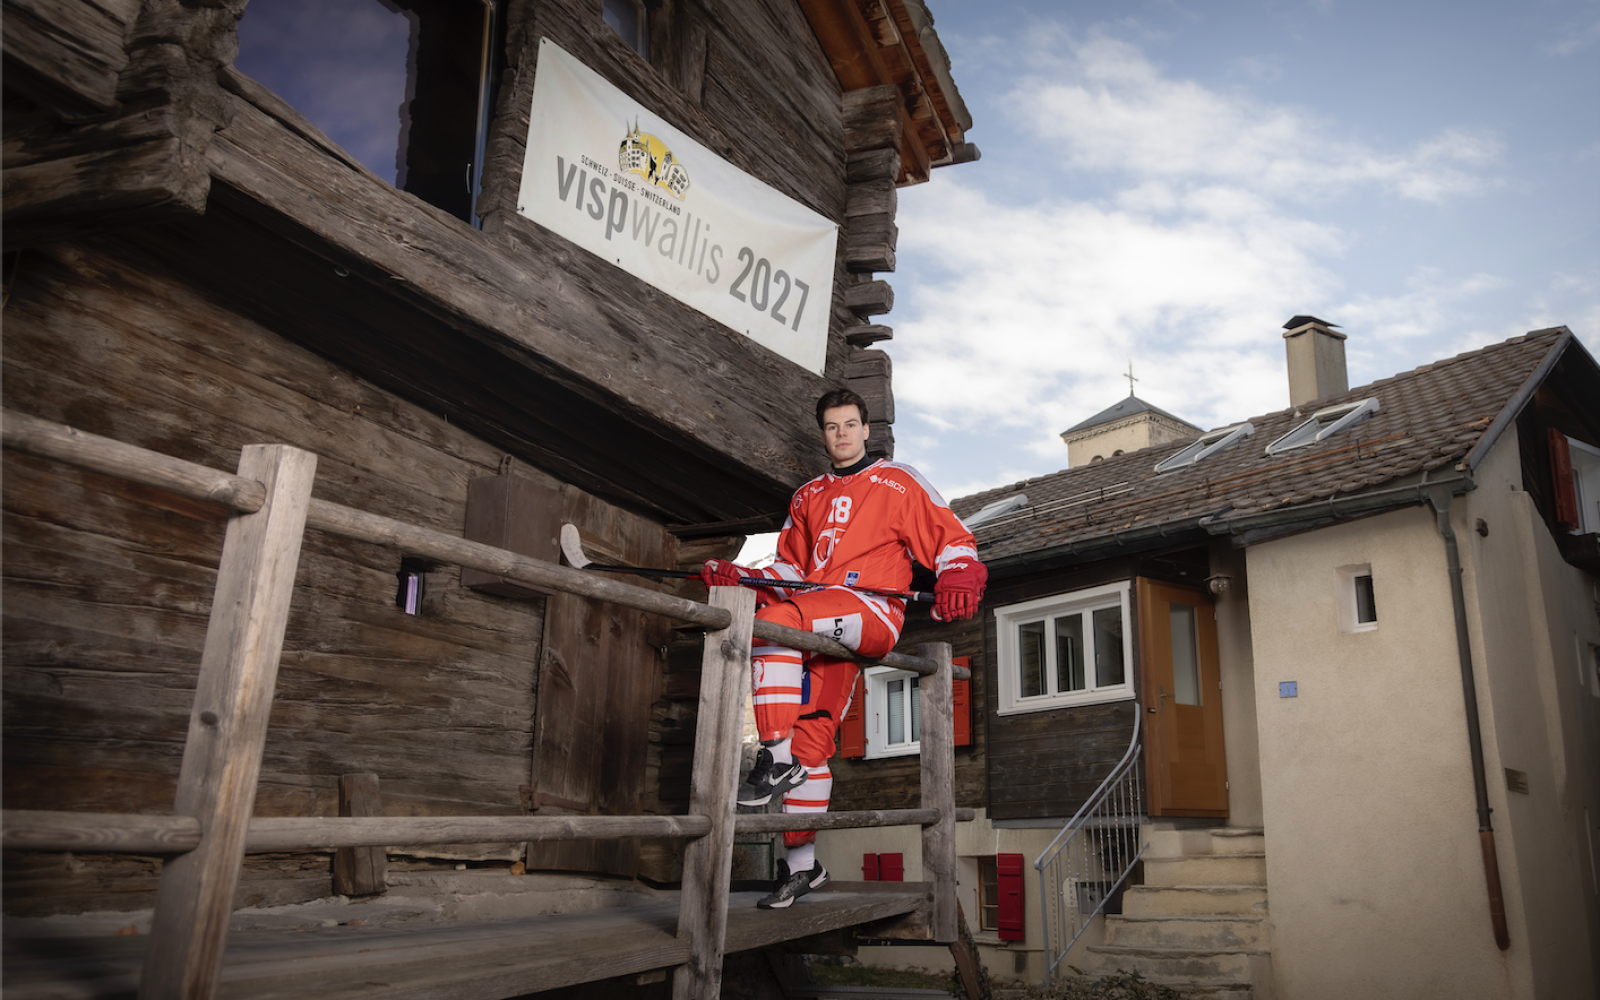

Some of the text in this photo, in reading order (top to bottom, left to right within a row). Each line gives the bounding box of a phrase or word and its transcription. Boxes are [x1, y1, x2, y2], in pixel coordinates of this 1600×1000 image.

[581, 154, 681, 216] SCHWEIZ SUISSE SWITZERLAND
[729, 246, 810, 332] 2027
[827, 495, 853, 524] 18
